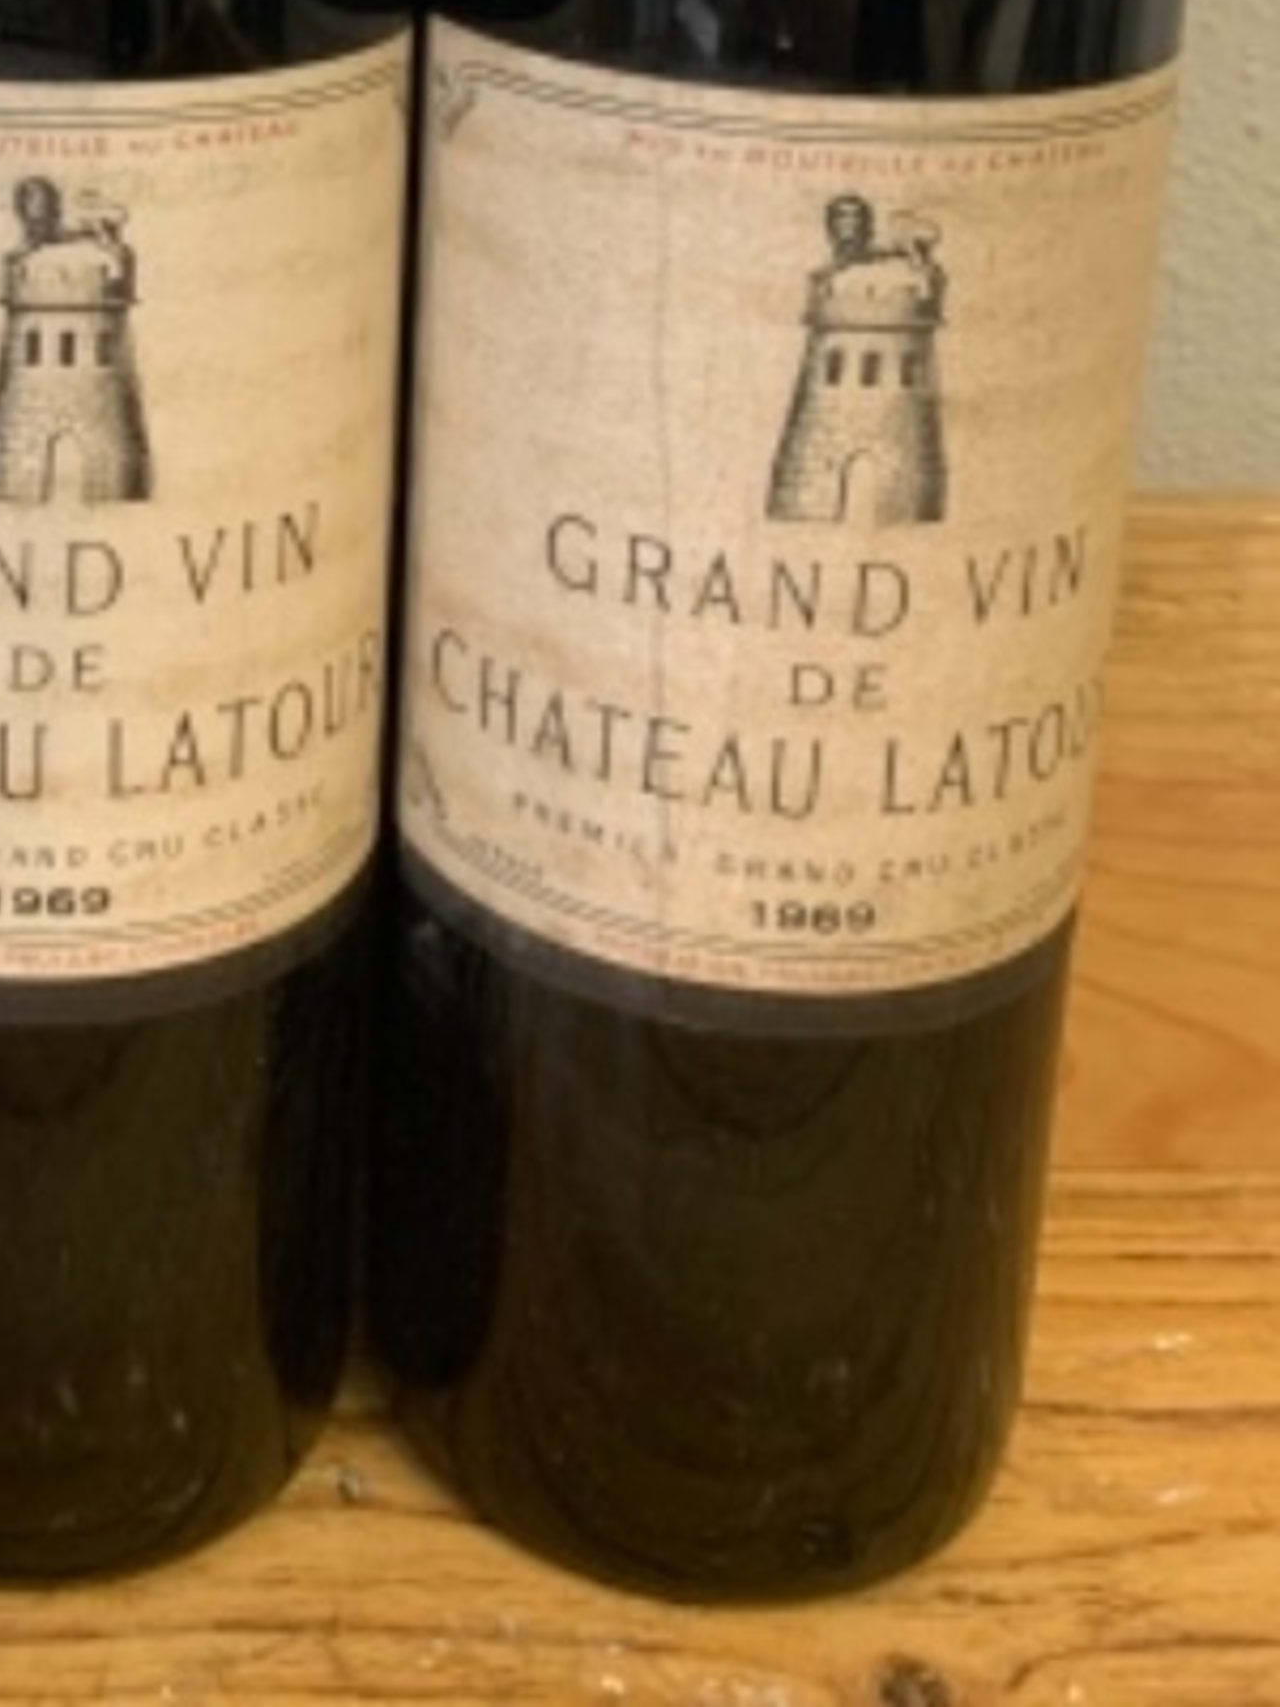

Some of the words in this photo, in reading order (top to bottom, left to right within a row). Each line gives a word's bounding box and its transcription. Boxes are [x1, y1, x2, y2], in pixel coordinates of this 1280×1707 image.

[176, 500, 321, 605] VIN
[545, 512, 911, 638] GRAND
[964, 525, 1088, 628] VIN
[9, 644, 109, 695] DE
[789, 662, 890, 712] DE
[430, 627, 823, 821] CHATEAU
[879, 678, 1106, 817] LATOU
[107, 834, 185, 867] CRU
